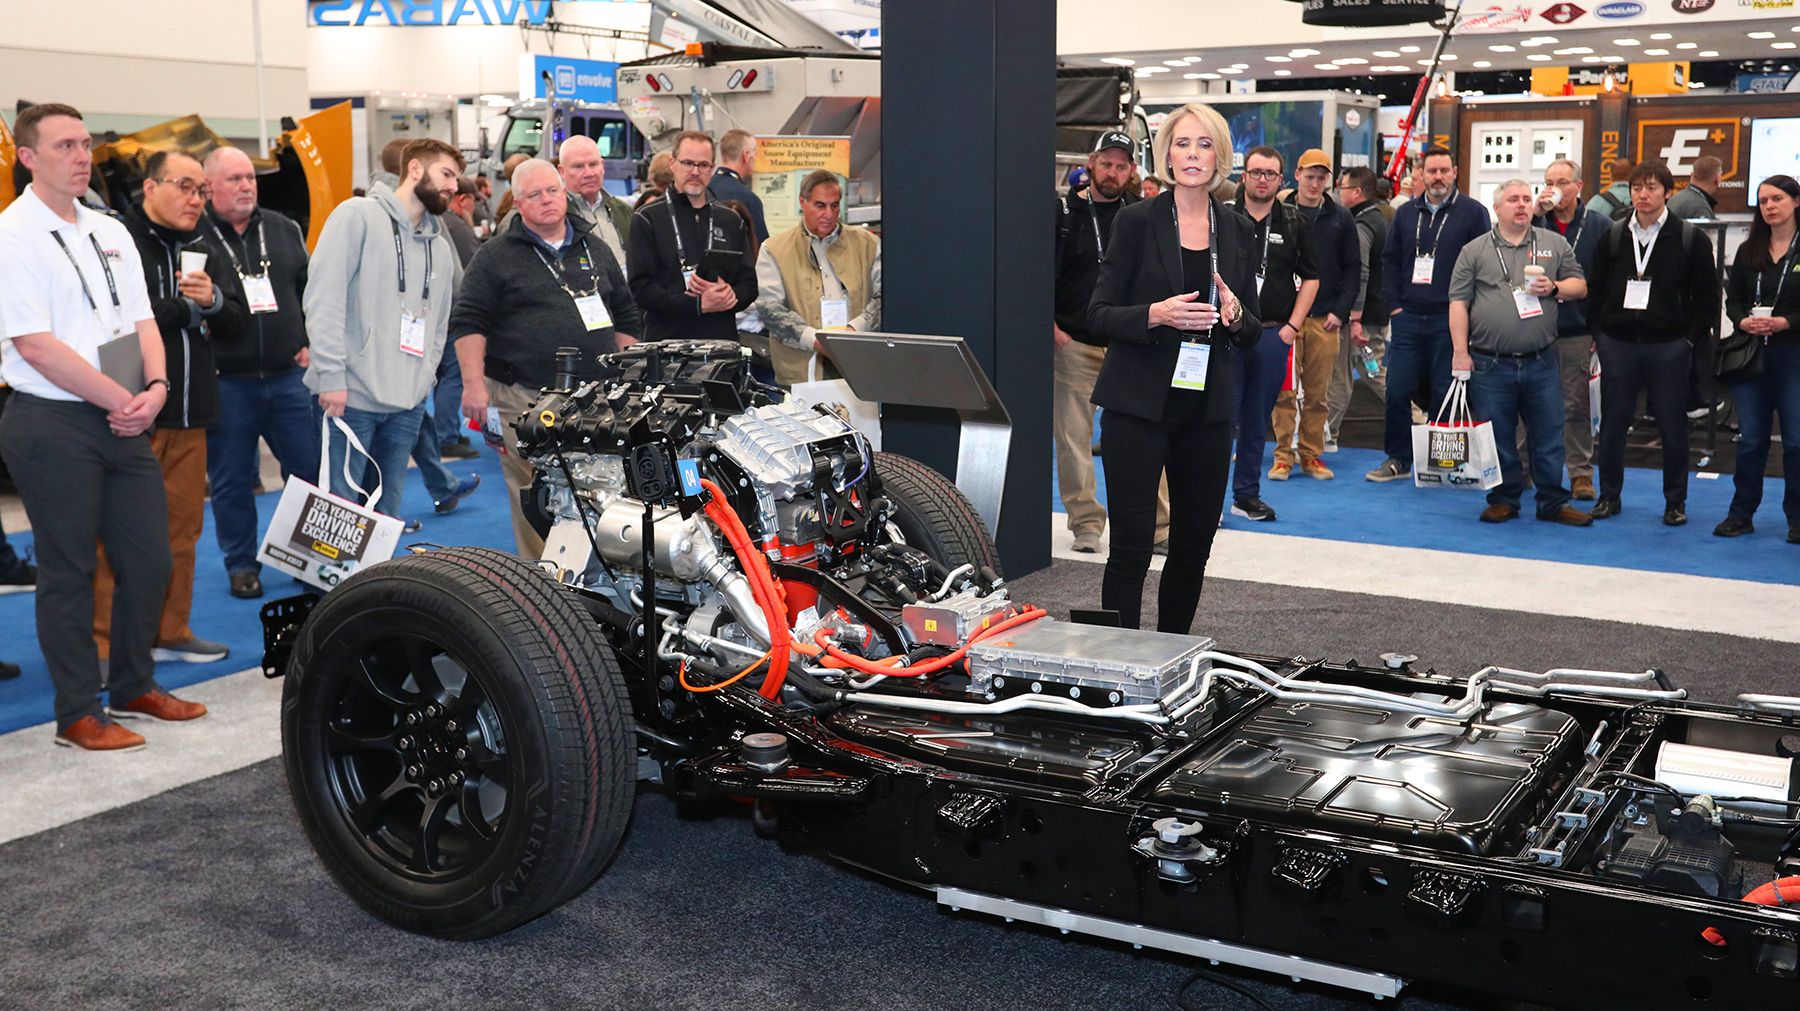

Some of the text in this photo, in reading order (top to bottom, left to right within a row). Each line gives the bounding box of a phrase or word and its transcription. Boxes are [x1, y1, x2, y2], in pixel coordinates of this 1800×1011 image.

[704, 9, 751, 41] COASTAL
[577, 73, 612, 88] envolve
[1580, 69, 1627, 84] Parr
[761, 140, 836, 150] America's Original
[787, 150, 832, 159] Equipment
[1431, 440, 1465, 452] DRIVING
[312, 497, 330, 513] 120
[330, 505, 358, 524] YEARS
[306, 508, 364, 544] DRIVING
[302, 522, 359, 556] EXCELLENCE
[504, 805, 548, 893] ALENZA
